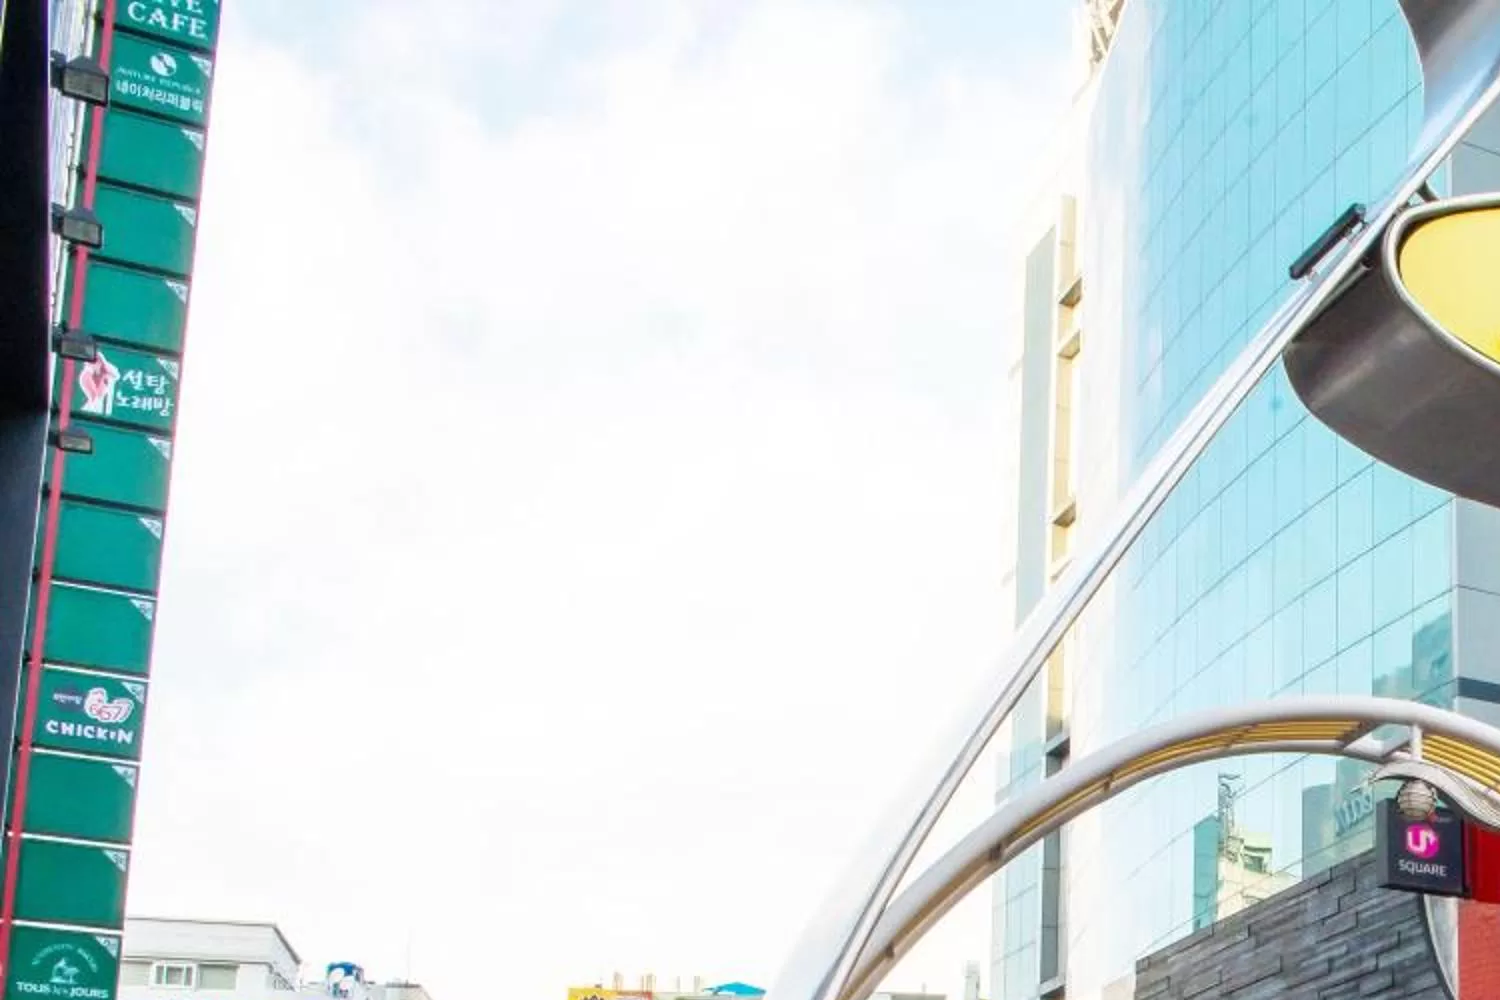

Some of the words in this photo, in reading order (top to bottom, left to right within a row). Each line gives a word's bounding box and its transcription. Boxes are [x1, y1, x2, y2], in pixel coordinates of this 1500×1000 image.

[127, 1, 209, 40] CAFE
[116, 389, 174, 417] 노래방
[1398, 858, 1448, 877] SQUARE
[16, 981, 51, 995] TOUS
[69, 986, 109, 999] JOURS
